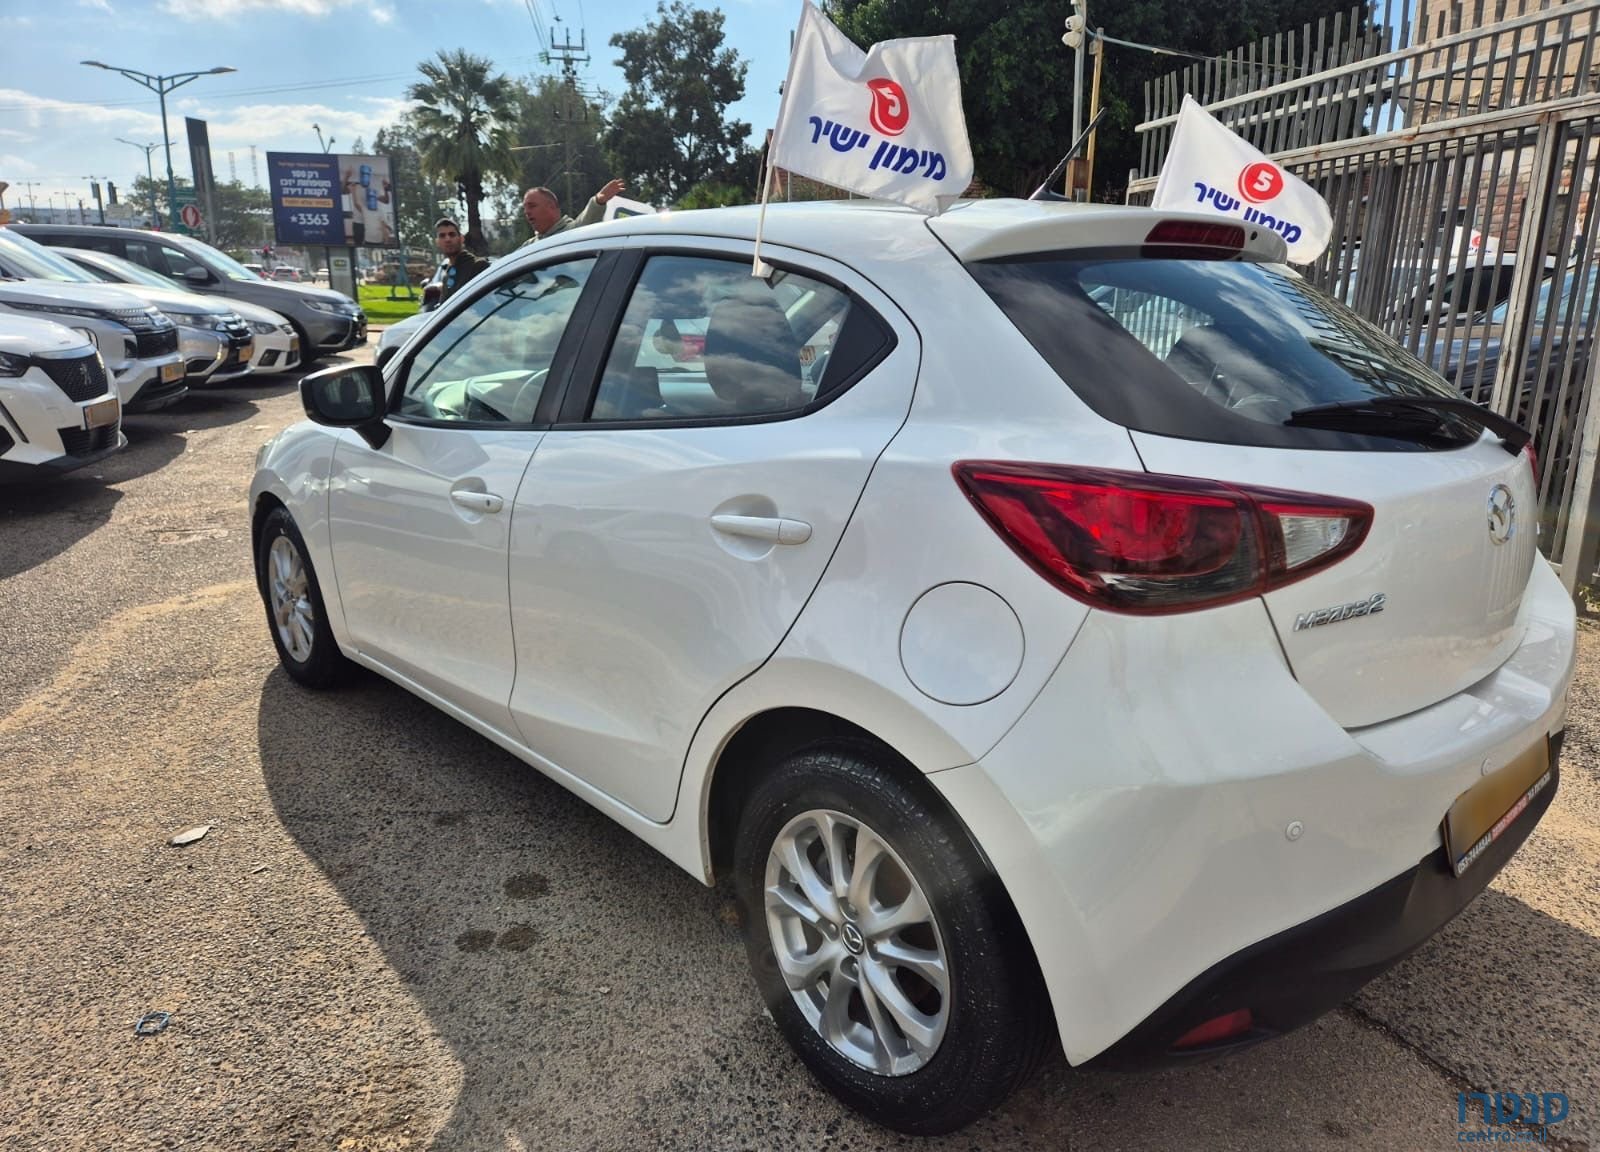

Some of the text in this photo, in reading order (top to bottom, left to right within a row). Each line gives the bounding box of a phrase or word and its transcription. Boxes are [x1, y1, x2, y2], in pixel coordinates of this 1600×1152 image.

[809, 115, 947, 181] מימון ישיר
[1253, 170, 1274, 192] 5
[1194, 182, 1241, 212] ישיר
